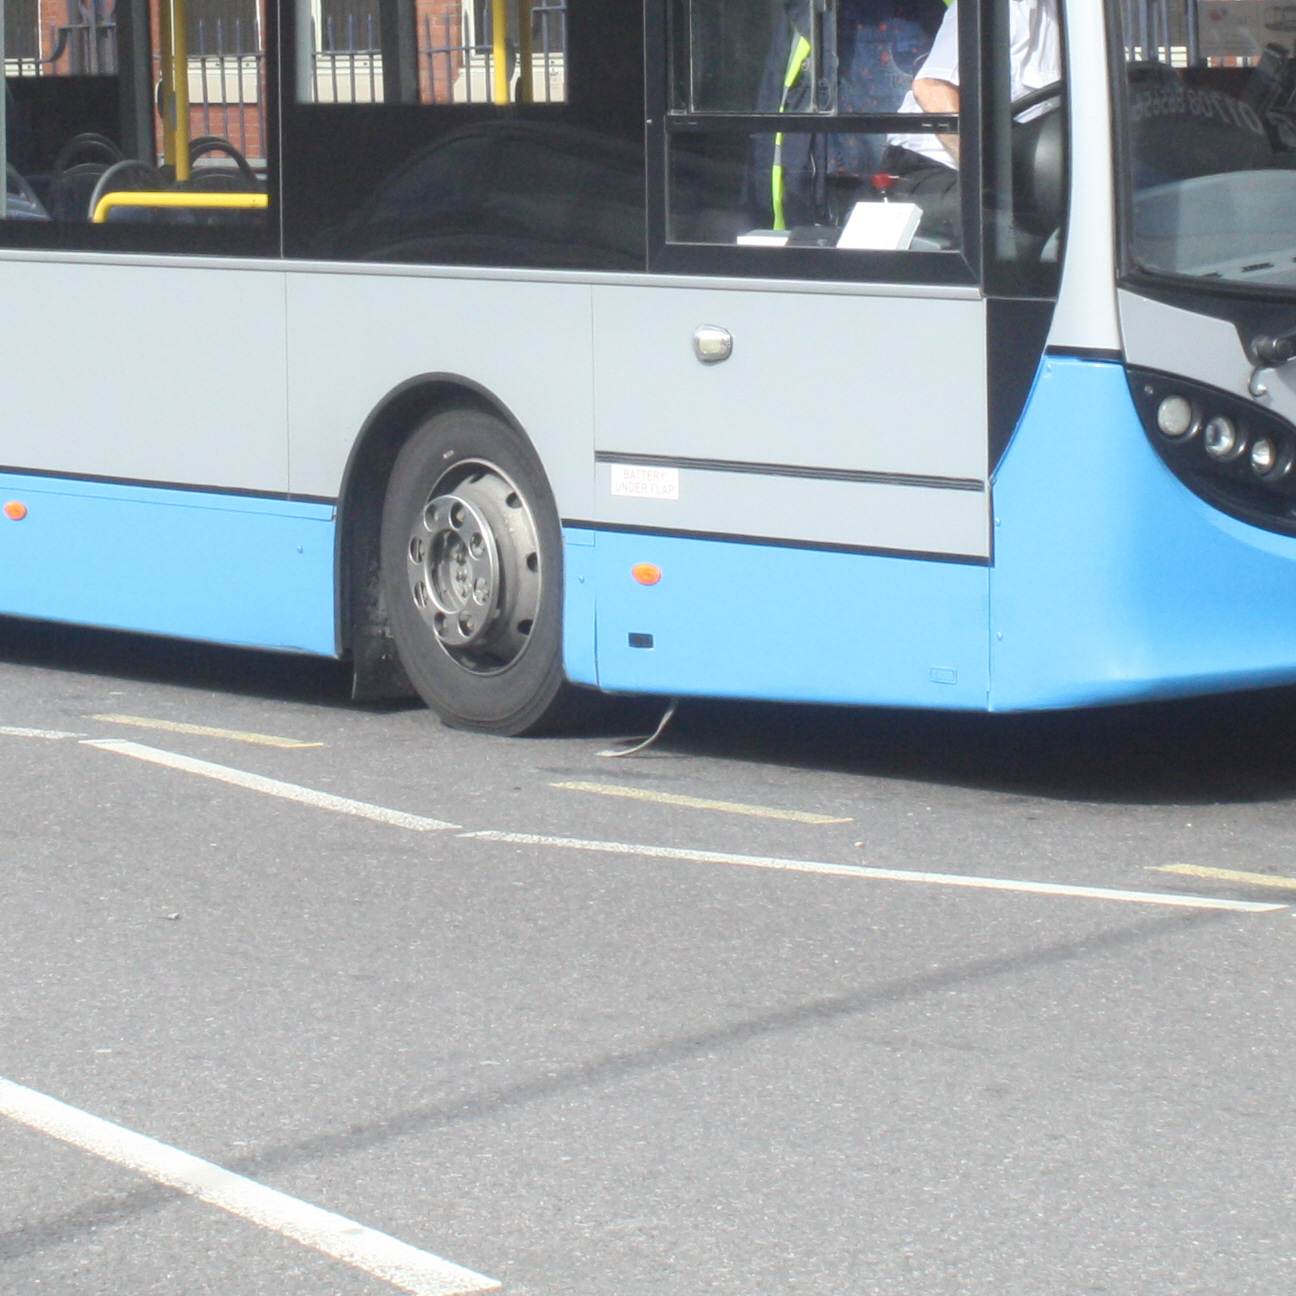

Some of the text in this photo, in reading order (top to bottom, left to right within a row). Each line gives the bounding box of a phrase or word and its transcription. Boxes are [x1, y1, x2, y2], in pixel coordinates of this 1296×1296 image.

[623, 468, 666, 482] BATTERY
[615, 481, 675, 495] UNDER FLAP
